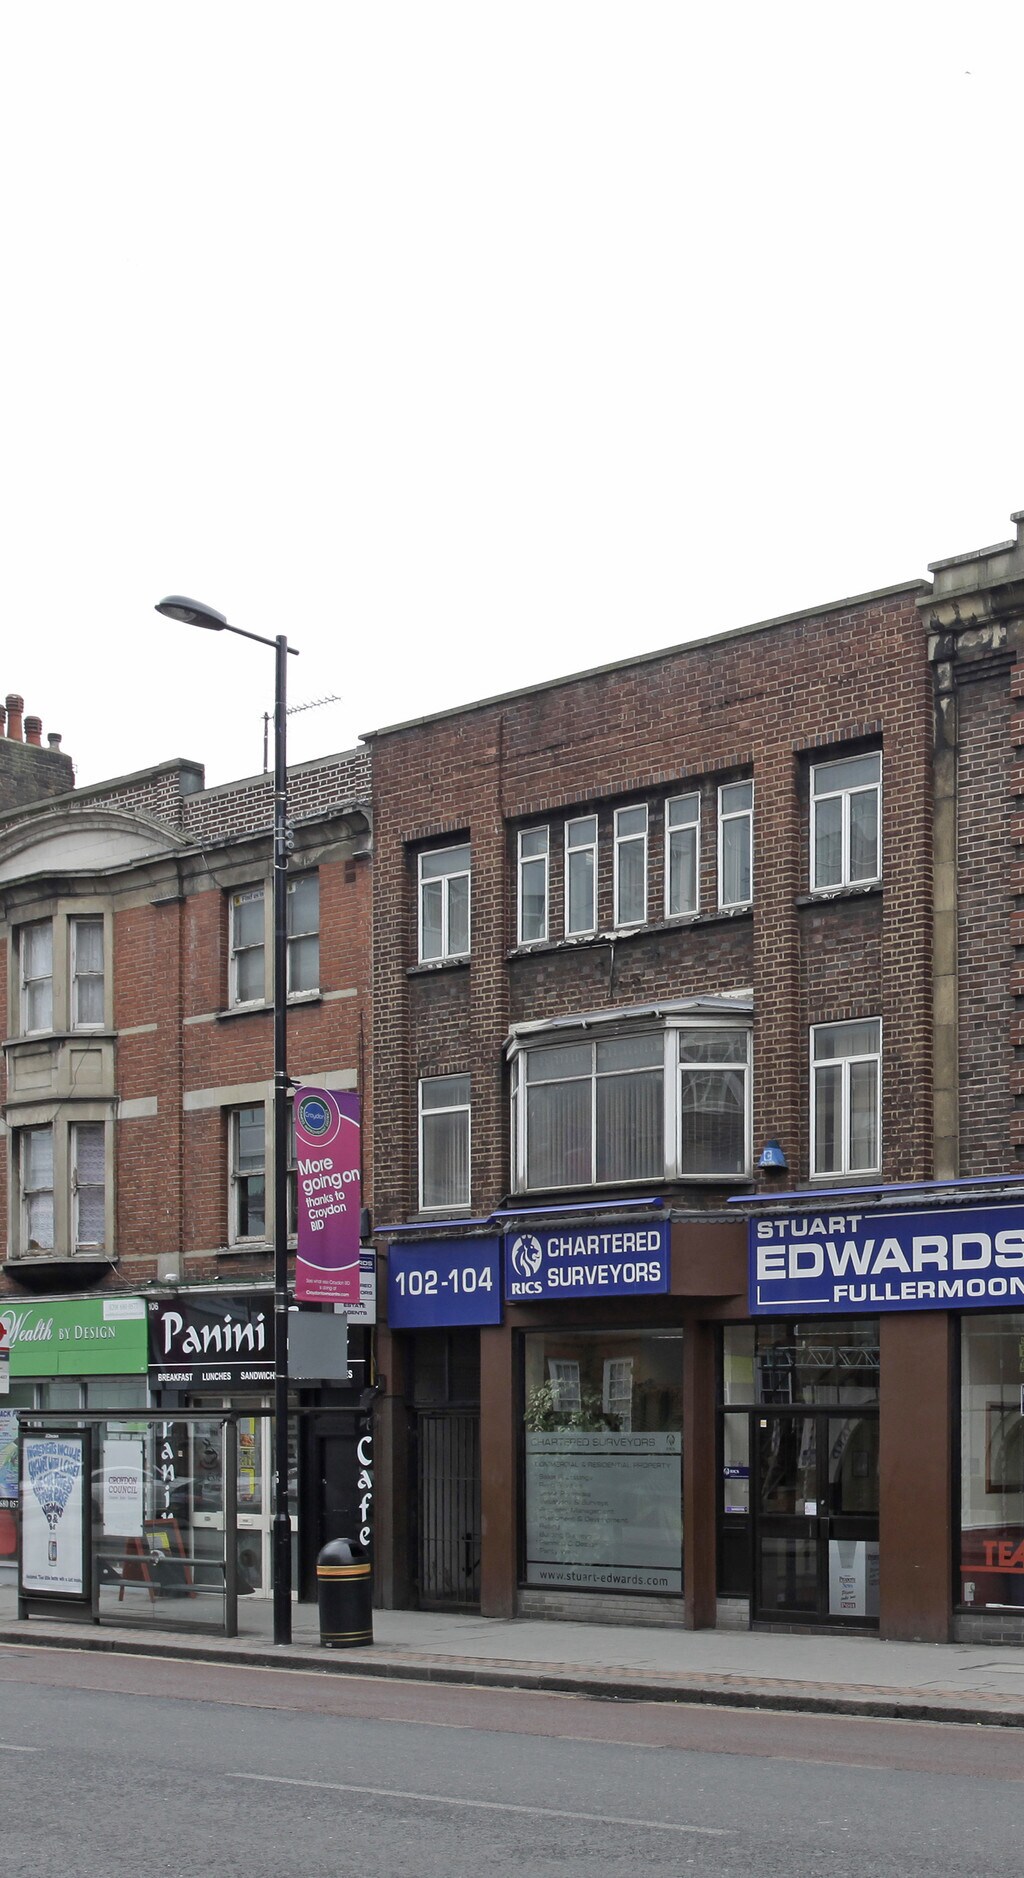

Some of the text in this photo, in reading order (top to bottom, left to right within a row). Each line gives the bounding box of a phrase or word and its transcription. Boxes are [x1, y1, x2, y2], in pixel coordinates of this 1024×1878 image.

[298, 1158, 333, 1176] More
[302, 1168, 360, 1196] going on
[306, 1190, 345, 1208] thanks to
[308, 1203, 347, 1219] Croydon
[310, 1220, 324, 1231] BID
[757, 1215, 862, 1239] STUART
[547, 1231, 661, 1258] CHARTERED
[395, 1267, 492, 1296] 102-104
[547, 1262, 661, 1288] SURVEYORS
[511, 1281, 543, 1295] RICS
[148, 1302, 159, 1311] 106
[1, 1310, 116, 1349] Wealth BY DESIGN
[161, 1311, 265, 1355] Panini
[158, 1373, 193, 1382] BREAKFAST
[202, 1372, 231, 1381] LUNCHES
[240, 1371, 276, 1380] SANDWICH
[531, 1438, 656, 1447] CHARTERED SURVEYORS
[109, 1476, 138, 1485] CROYDON
[109, 1486, 138, 1494] COUNCIL
[540, 1571, 668, 1586] www.stuart-edwards.com
